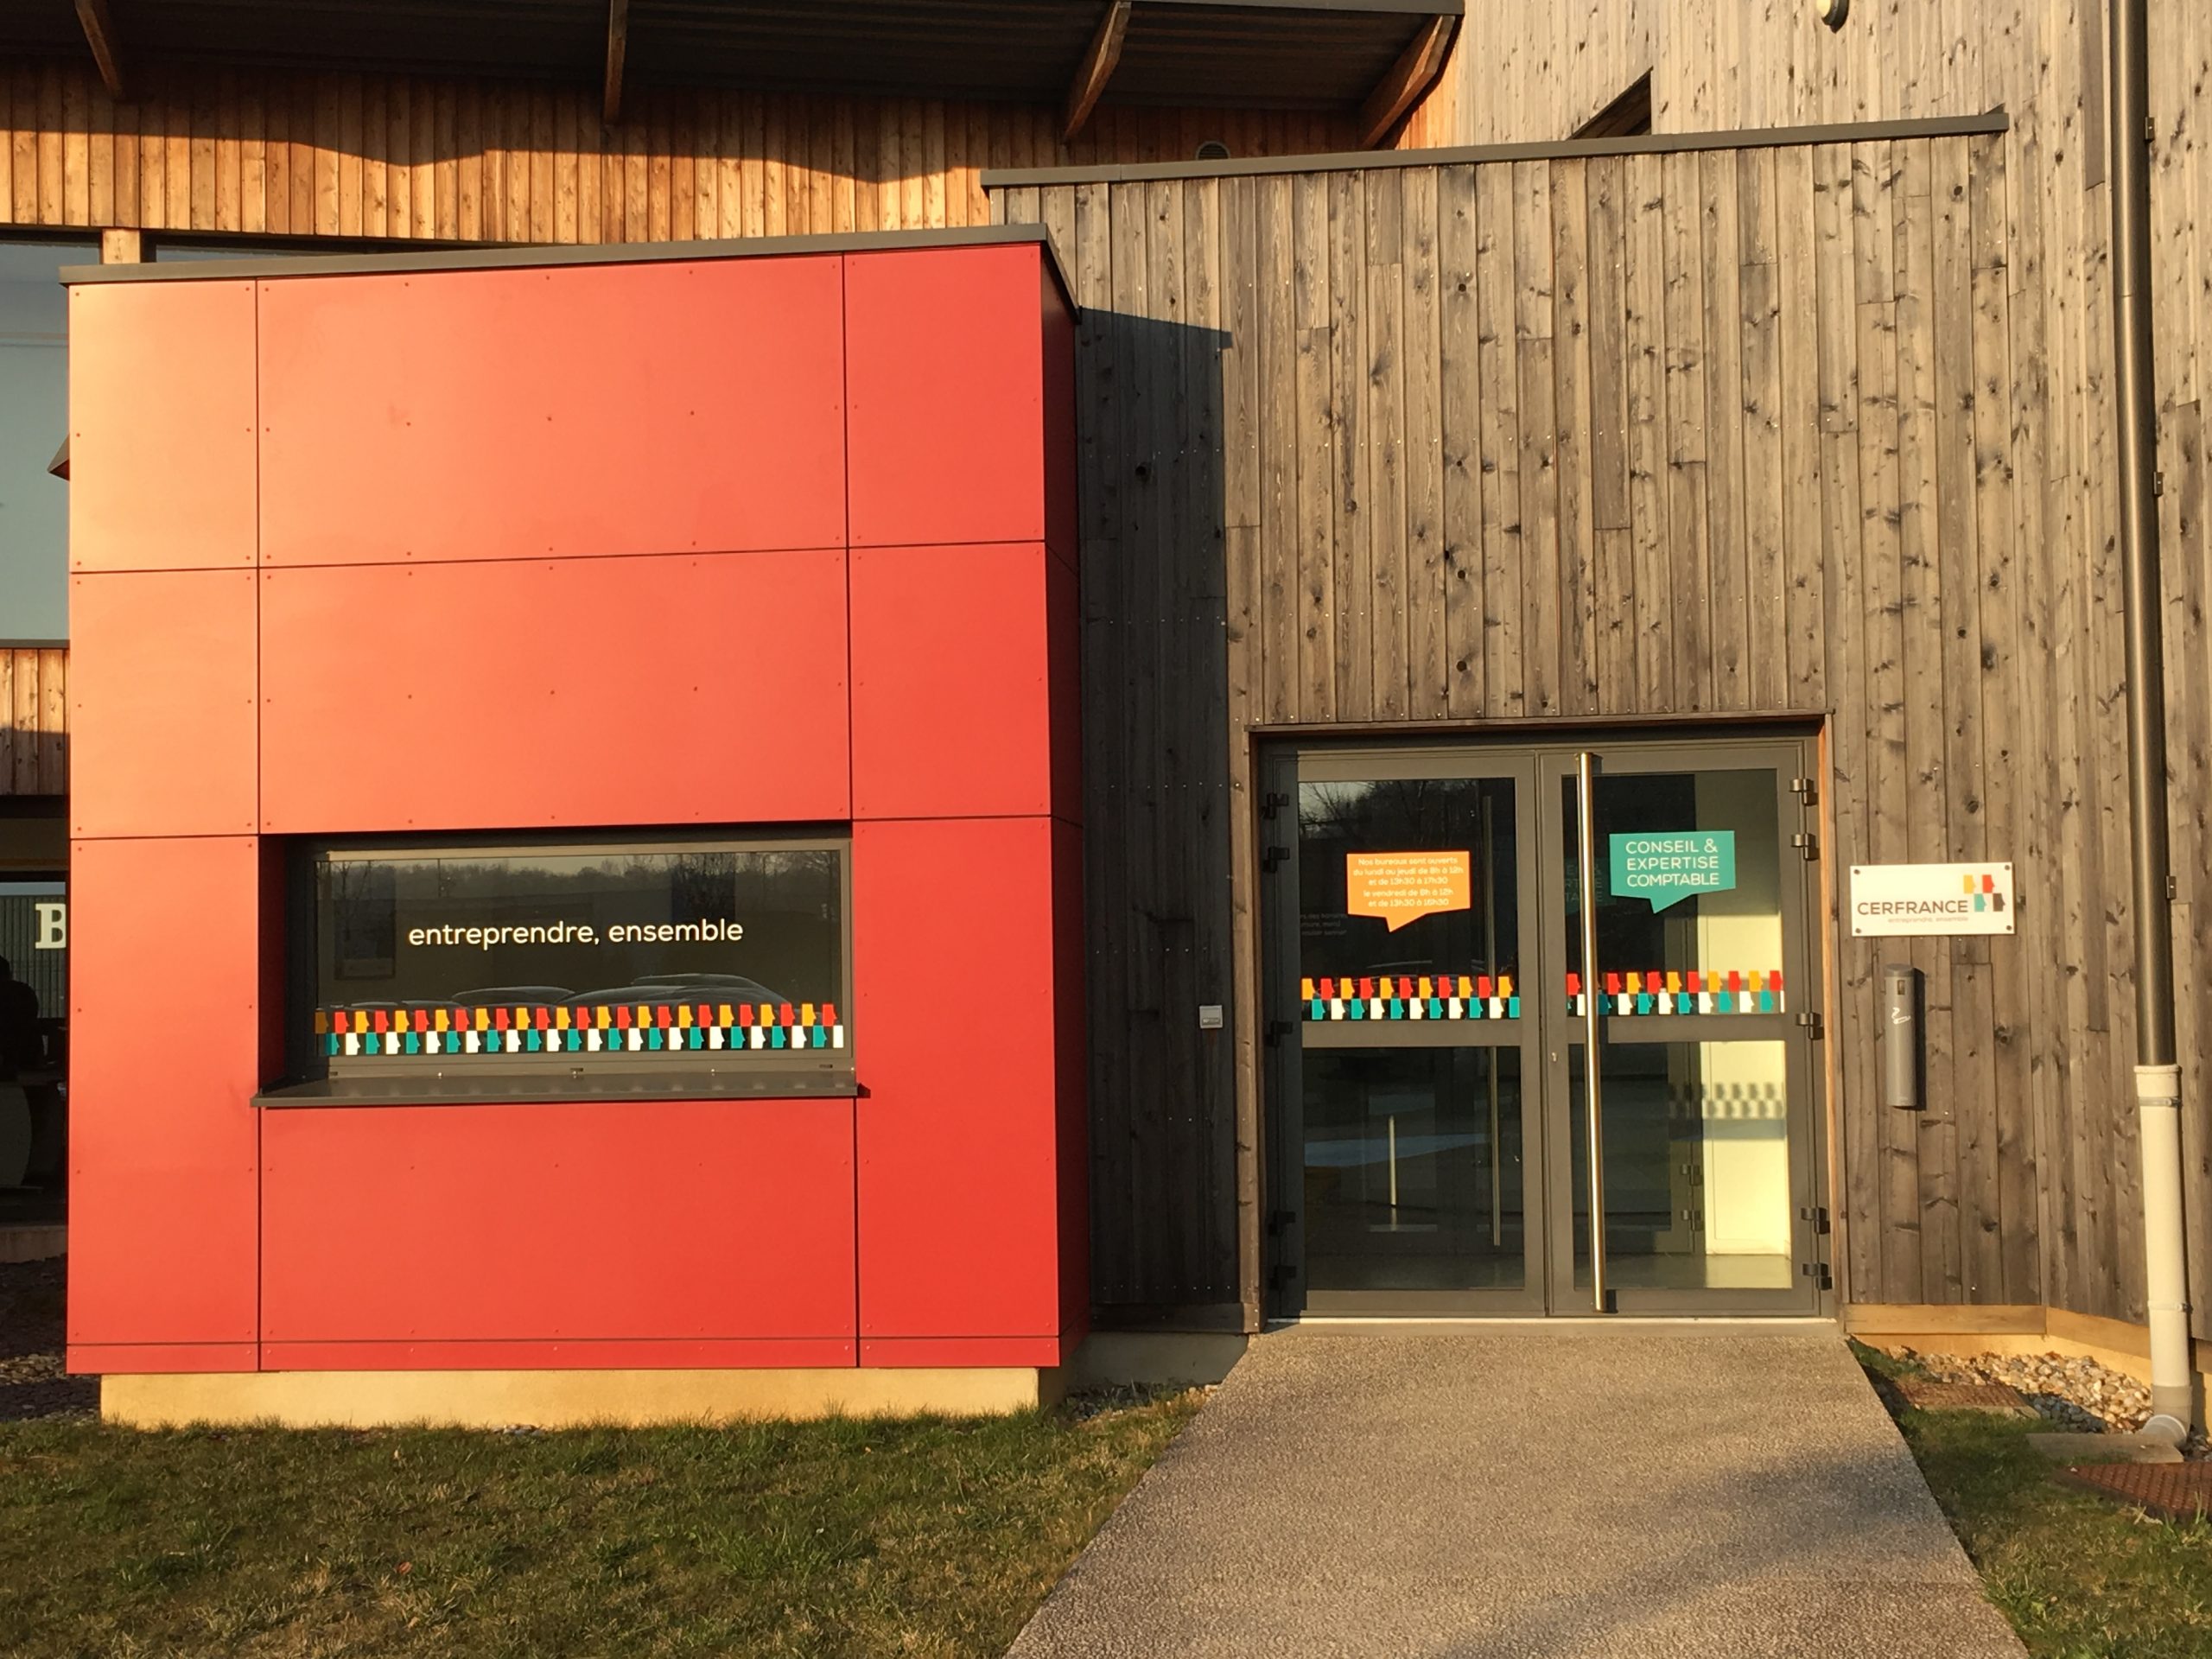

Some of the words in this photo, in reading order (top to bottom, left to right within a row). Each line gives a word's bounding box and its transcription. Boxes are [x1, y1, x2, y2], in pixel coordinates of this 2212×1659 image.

[1625, 840, 1699, 855] CONSEIL
[1703, 838, 1719, 853] &
[1427, 856, 1458, 865] ouverts
[1626, 855, 1719, 871] EXPERTISE
[1396, 867, 1416, 877] jeudi
[1626, 872, 1720, 887] COMPTABLE
[1371, 889, 1407, 898] vendredi
[1439, 887, 1454, 896] 12h
[1377, 899, 1389, 907] de
[1857, 899, 1968, 916] CERFRANCE
[408, 921, 601, 950] entreprendre,
[608, 918, 744, 942] ensemble
